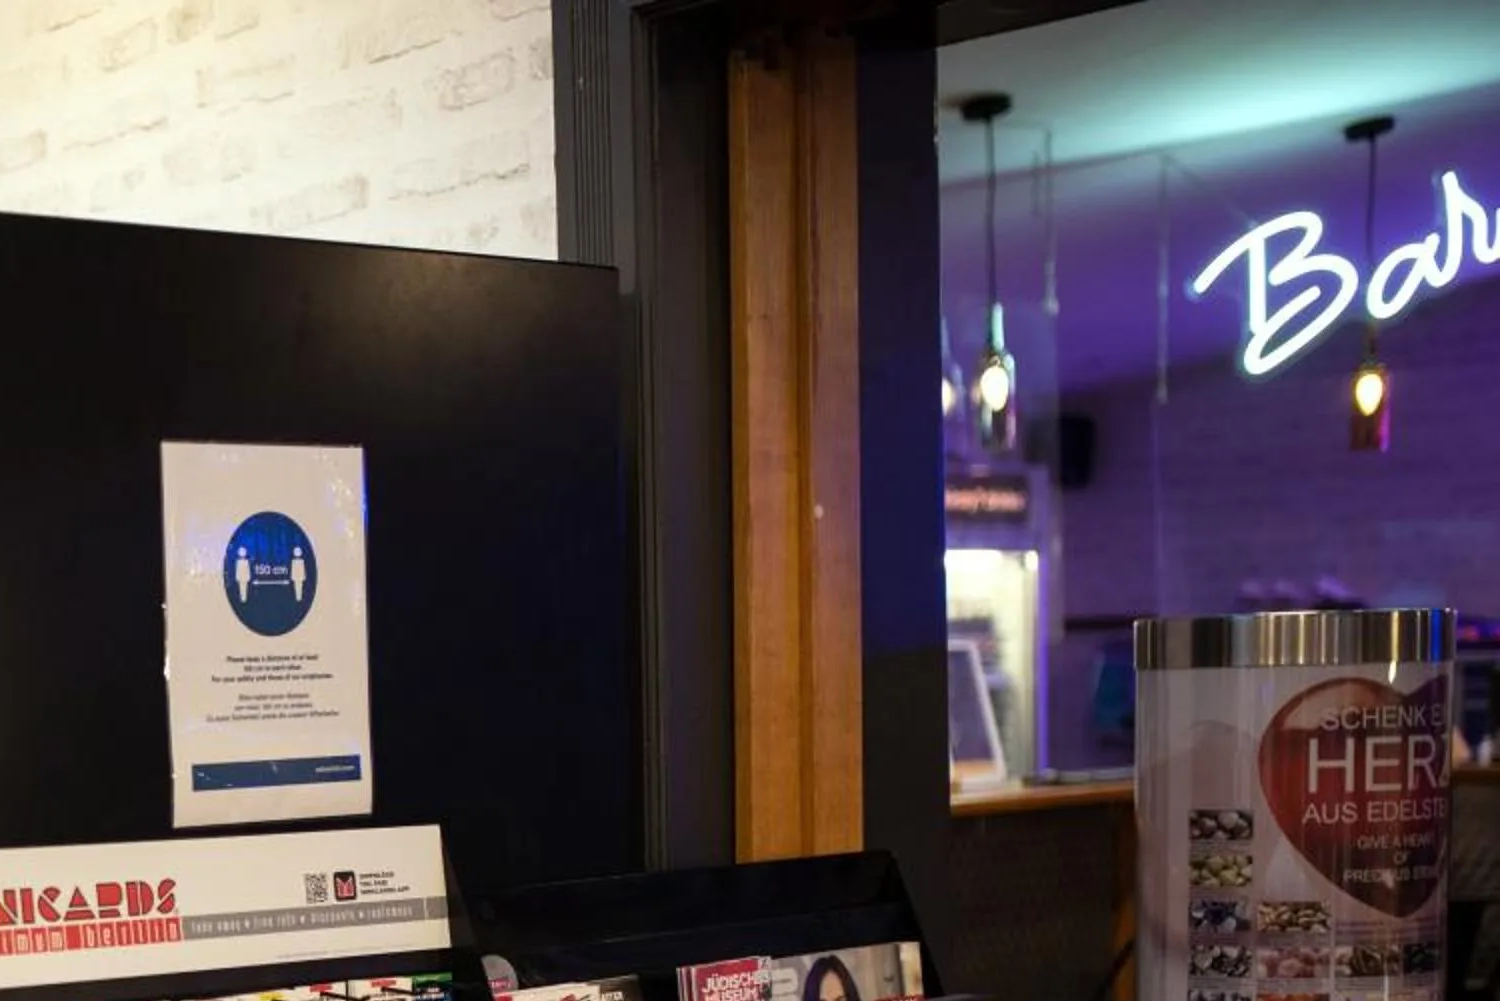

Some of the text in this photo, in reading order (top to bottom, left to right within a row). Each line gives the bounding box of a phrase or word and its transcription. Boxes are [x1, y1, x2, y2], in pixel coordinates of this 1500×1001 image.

[1319, 703, 1426, 731] SCHENK
[1301, 802, 1359, 825] AUS
[87, 919, 178, 948] berlin
